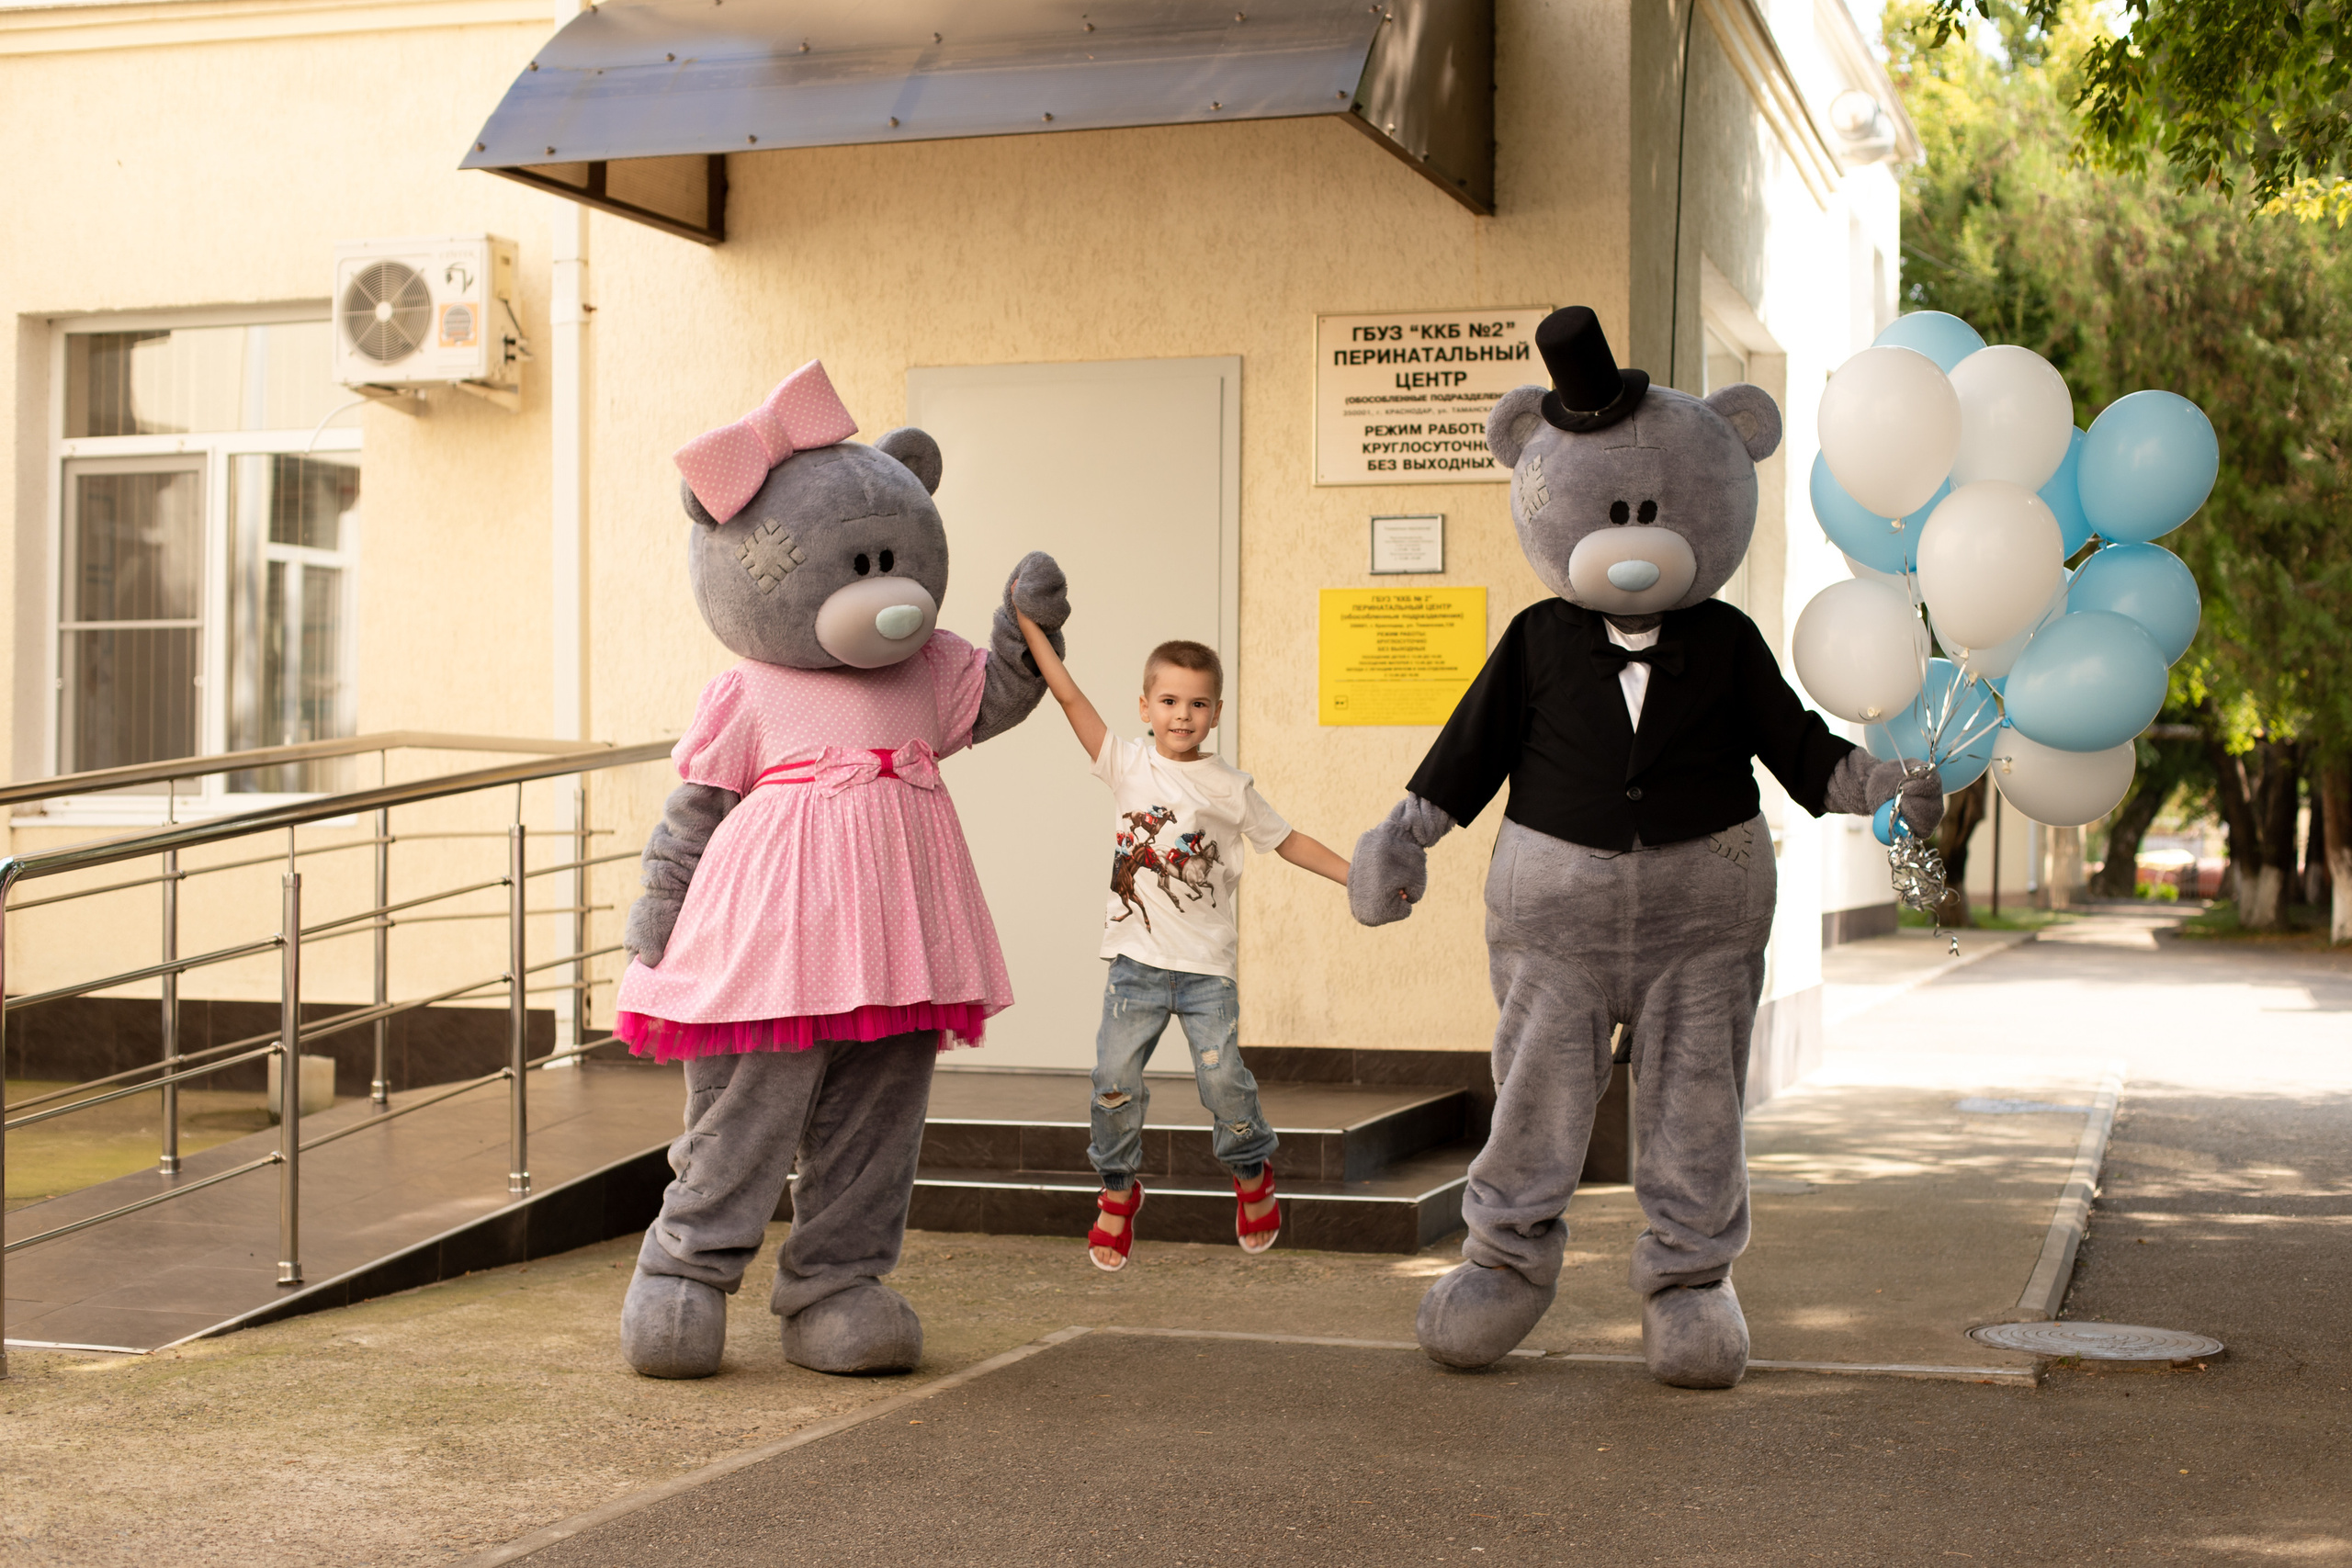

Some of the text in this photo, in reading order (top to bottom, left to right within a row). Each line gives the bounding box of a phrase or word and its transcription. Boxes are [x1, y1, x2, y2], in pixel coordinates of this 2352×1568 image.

[1352, 326, 1402, 342] ГБУЗ
[1334, 341, 1530, 366] ПЕРИНАТАЛЬНЫЙ
[1396, 371, 1467, 390] ЦЕНТР
[1345, 394, 1427, 406] (ОБОСОБЛЕННЫЕ
[1364, 423, 1422, 436] РЕЖИМ
[1367, 457, 1496, 472] БЕЗ ВЫХОДНЫХ
[1426, 603, 1452, 611] ЦЕНТР
